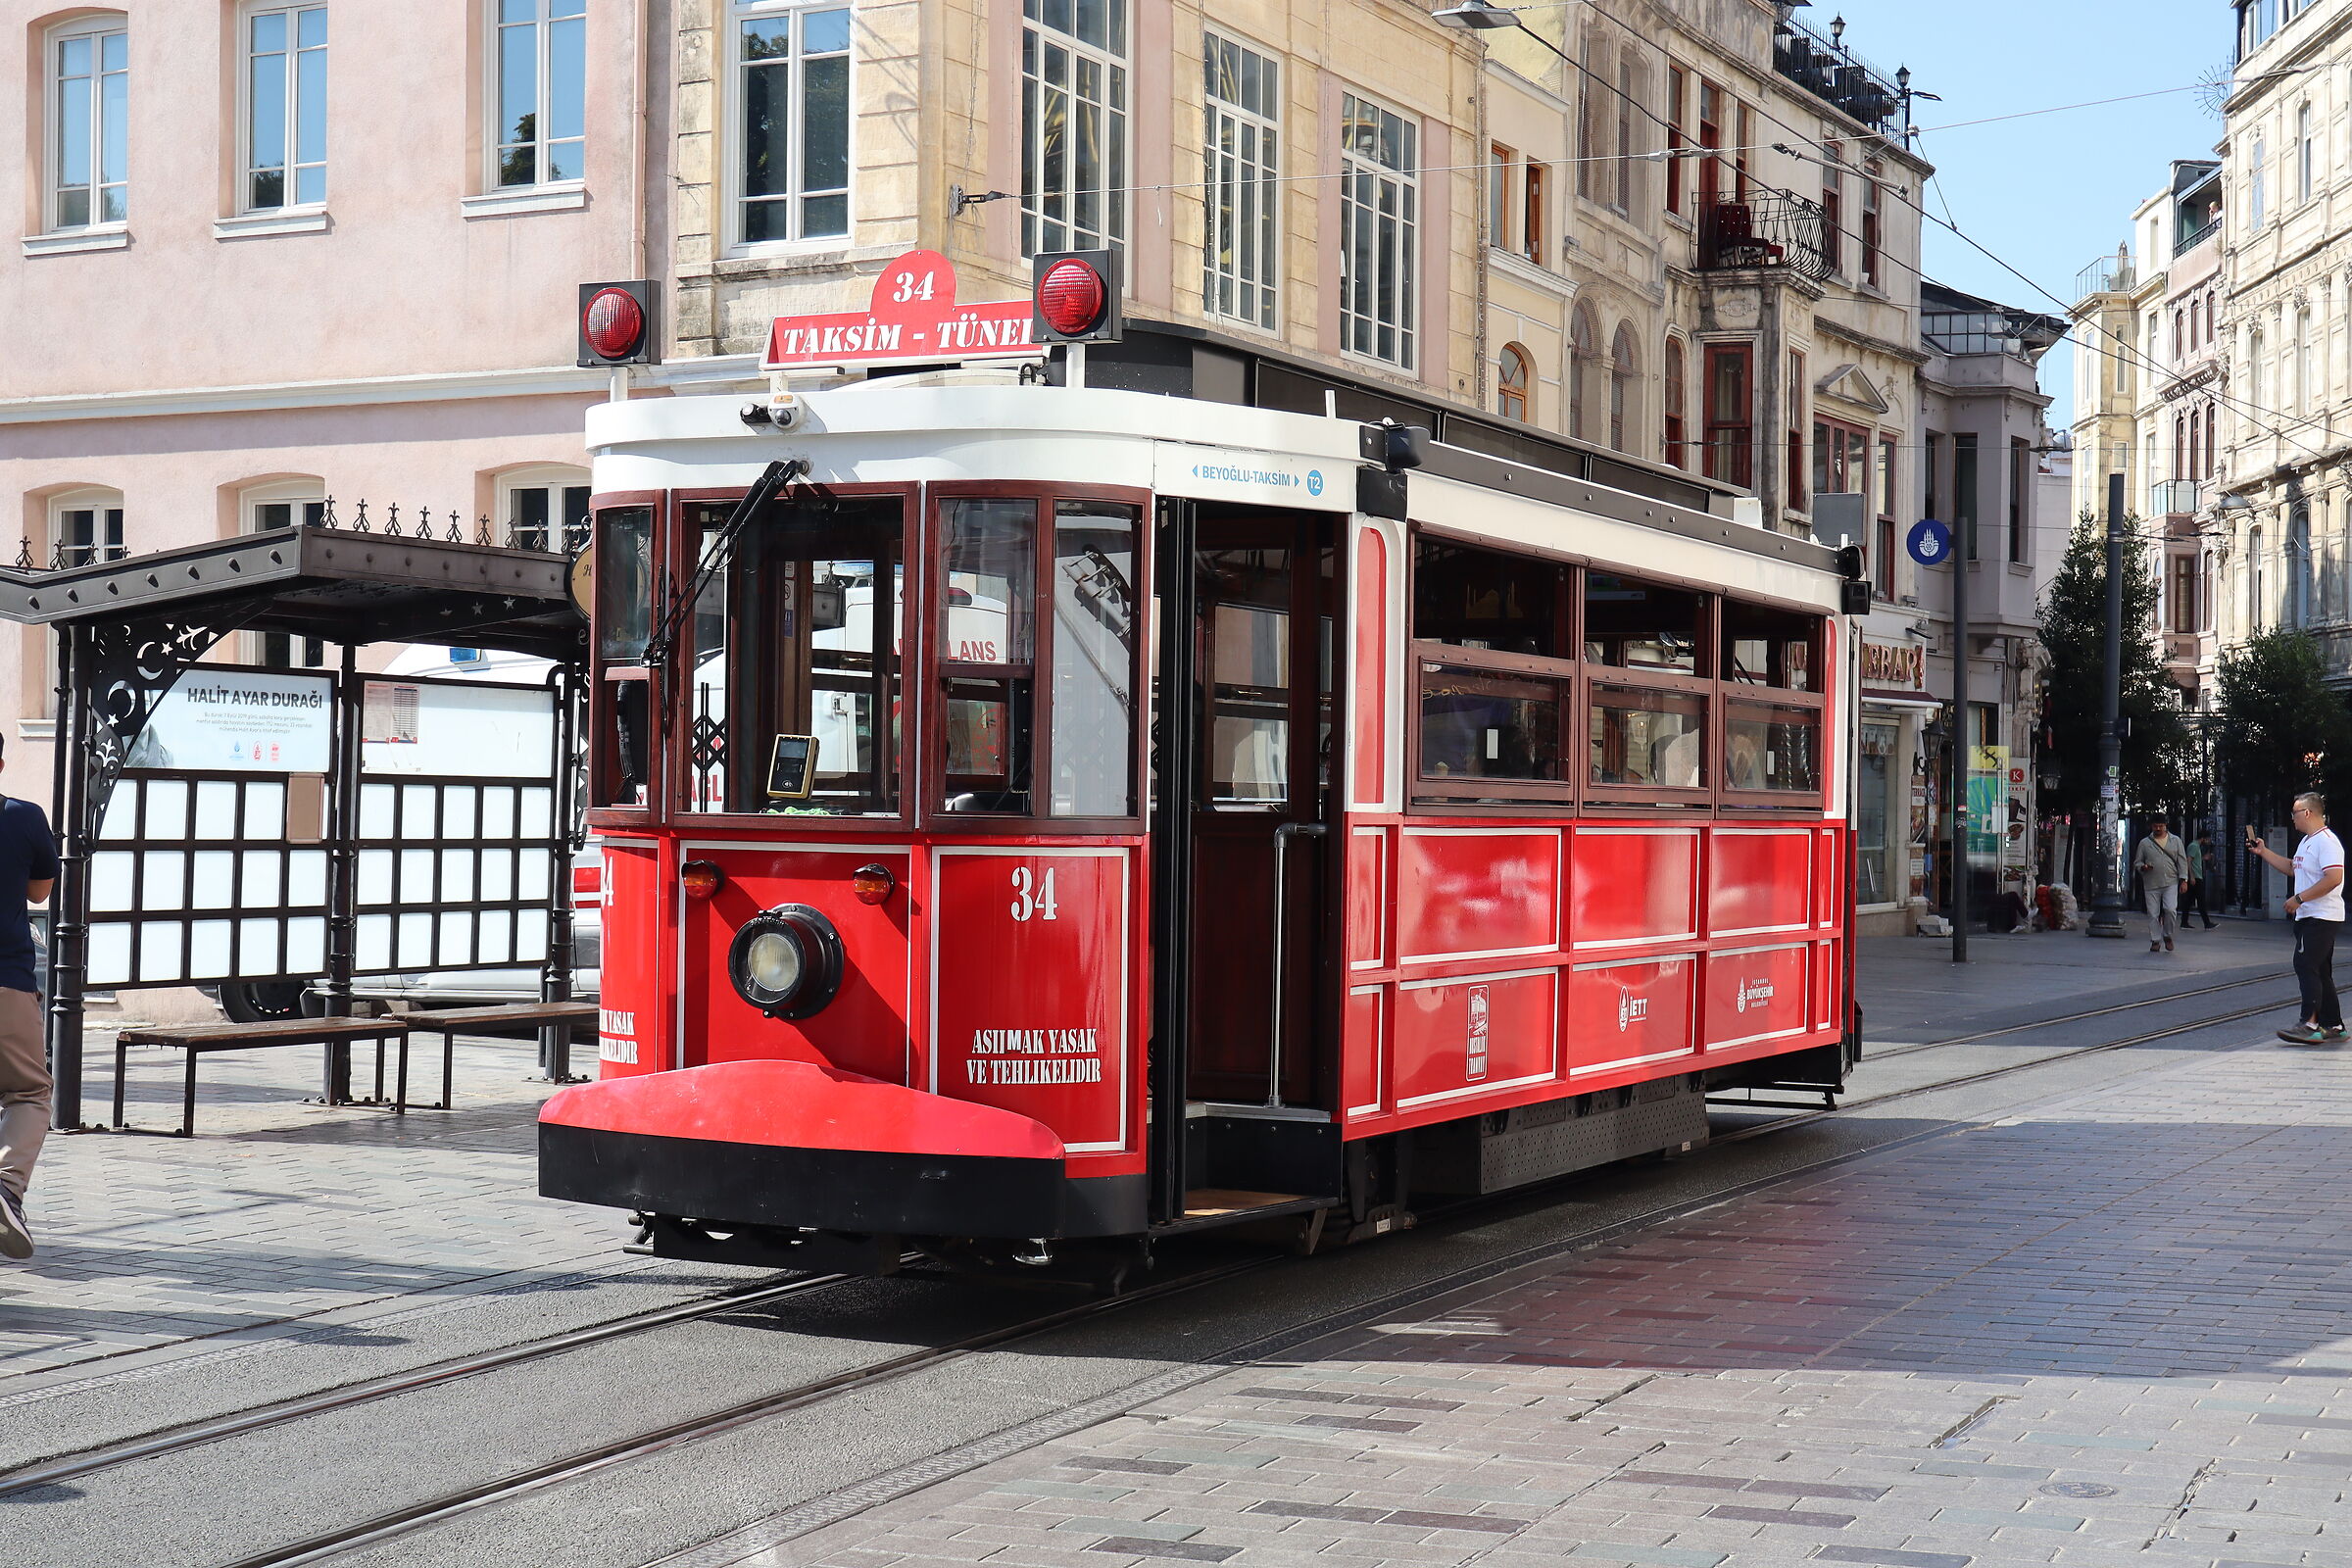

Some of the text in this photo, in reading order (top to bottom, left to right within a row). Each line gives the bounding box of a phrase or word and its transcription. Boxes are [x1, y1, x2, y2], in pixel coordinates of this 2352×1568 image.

[893, 271, 935, 303] 34
[784, 318, 904, 355] TAKSİM
[1201, 465, 1321, 490] BEYOĞLU-TAKSİM T2
[187, 684, 322, 709] HALİT AYAR DURAĞI
[1010, 866, 1058, 921] 34
[1629, 997, 1648, 1017] İETT
[608, 1009, 635, 1036] YASAK
[1048, 1028, 1098, 1054] YASAK
[966, 1058, 1102, 1085] VE TEHLIKELIDIR
